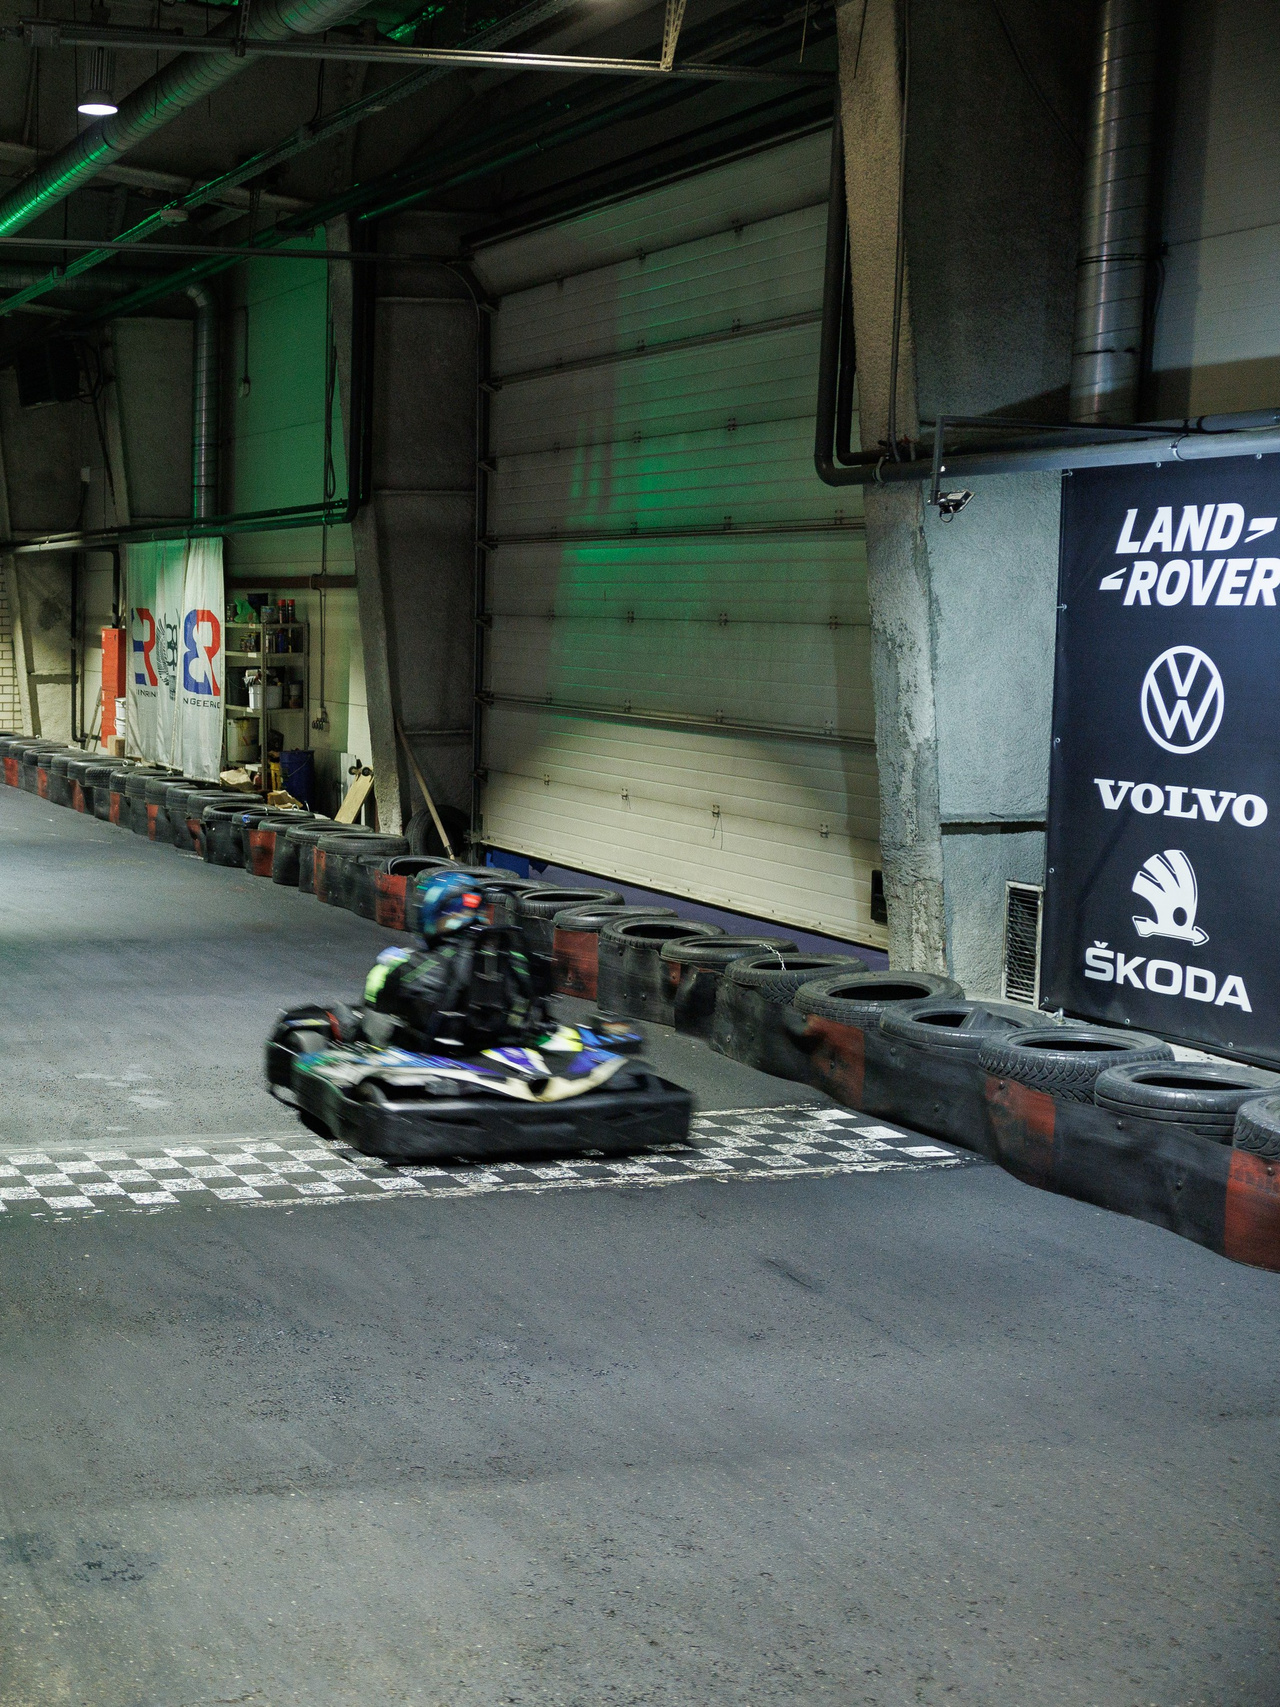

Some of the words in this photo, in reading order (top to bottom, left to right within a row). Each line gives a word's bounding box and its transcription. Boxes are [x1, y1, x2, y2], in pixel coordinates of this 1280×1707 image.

[1115, 503, 1245, 554] LAND
[1123, 558, 1280, 606] ROVER
[1094, 778, 1268, 827] VOLVO
[1085, 941, 1252, 1012] ŠKODA
